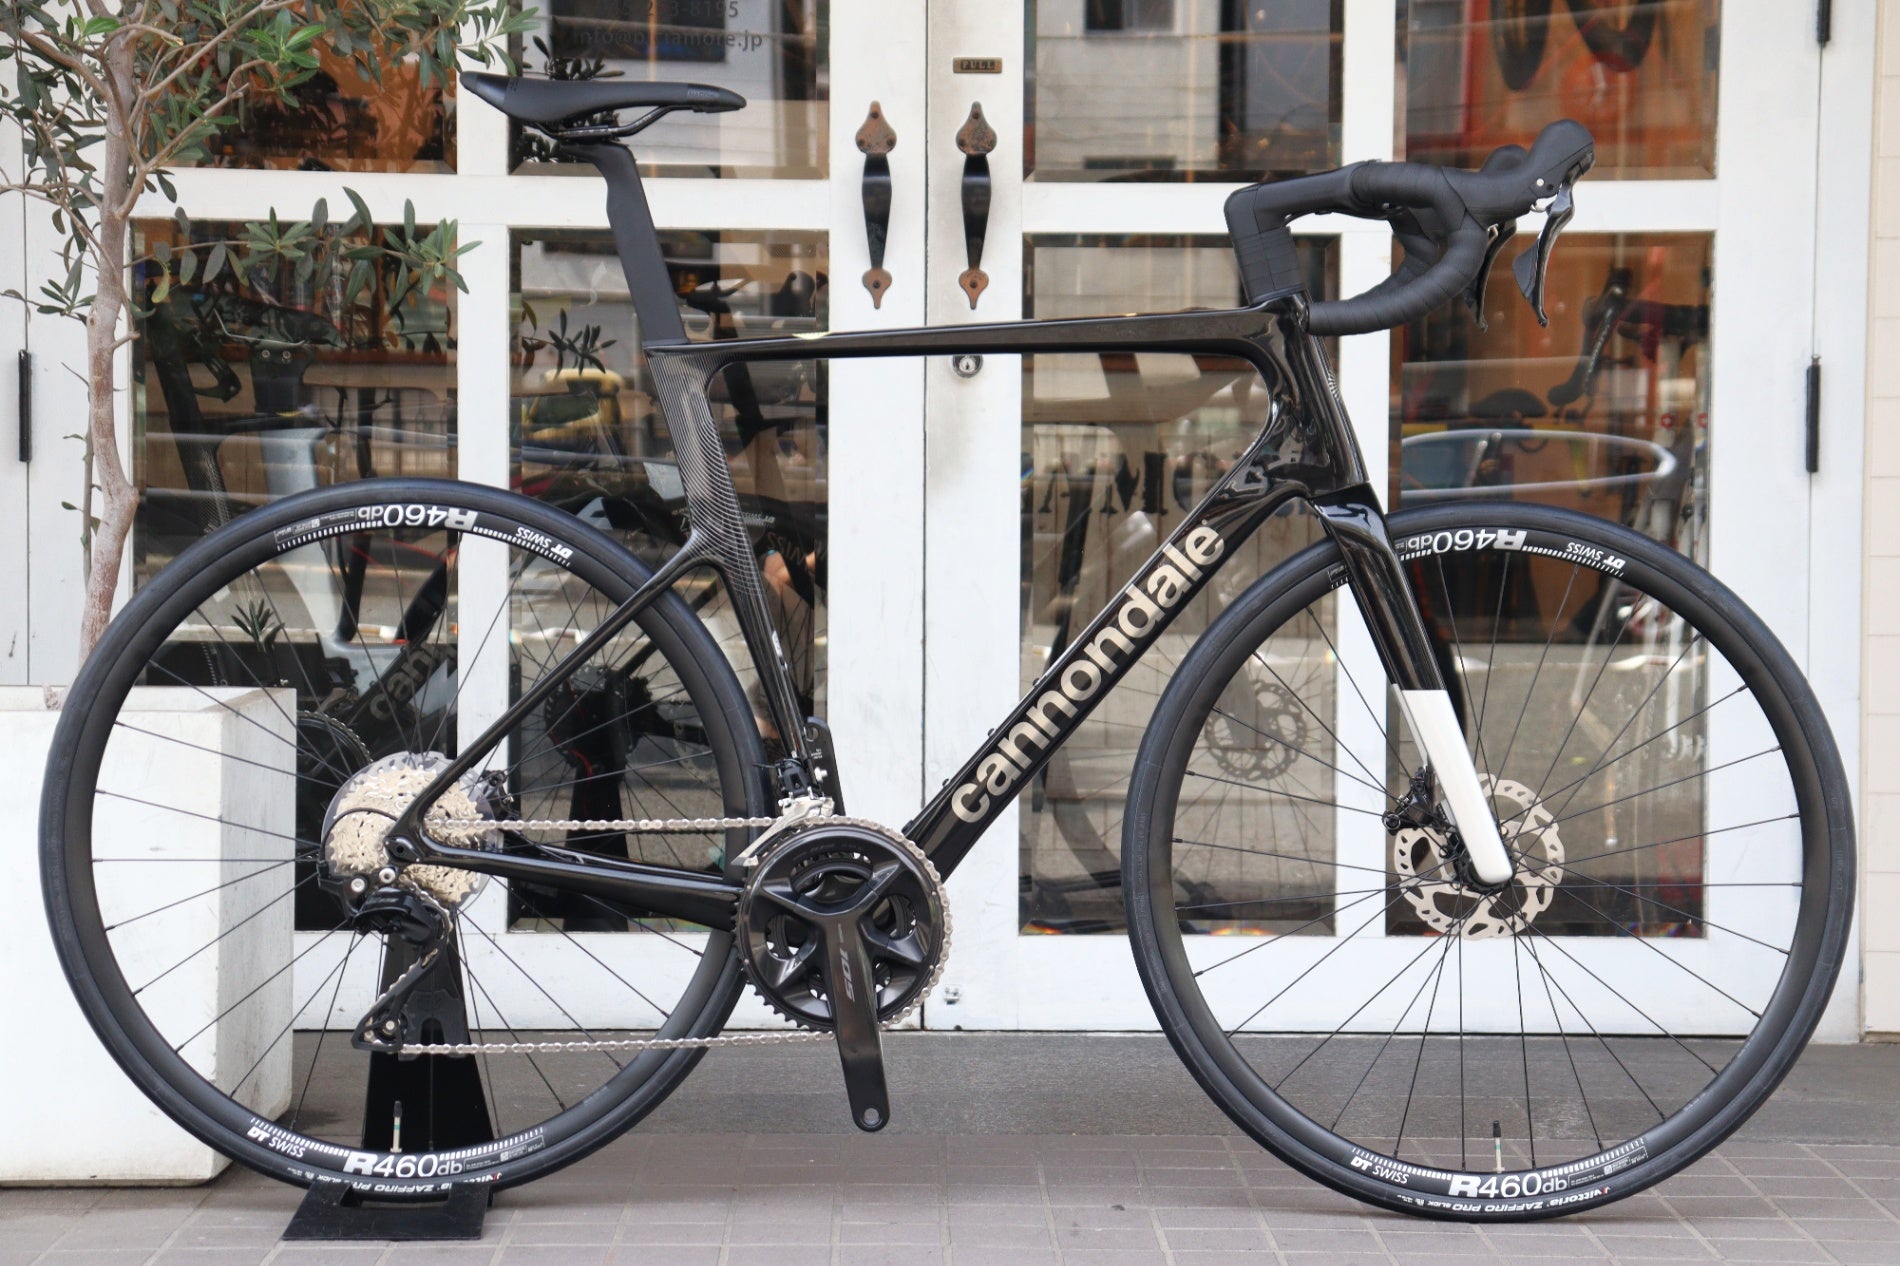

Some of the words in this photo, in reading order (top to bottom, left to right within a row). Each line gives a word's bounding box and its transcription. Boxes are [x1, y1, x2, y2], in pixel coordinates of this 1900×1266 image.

[962, 60, 994, 69] PULL
[357, 503, 478, 531] R460db
[515, 526, 552, 549] SWISS
[1407, 529, 1528, 553] R460db
[551, 543, 574, 559] DT
[1566, 541, 1604, 561] SWISS
[1603, 554, 1626, 570] DT
[951, 525, 1225, 824] cannondale
[839, 947, 856, 1003] 105
[247, 1125, 270, 1142] DT
[268, 1136, 306, 1158] SWISS
[343, 1151, 462, 1178] R460db
[1350, 1155, 1373, 1171] DT
[1372, 1165, 1410, 1185] SWISS
[1448, 1174, 1568, 1198] R460db
[1451, 1203, 1482, 1212] PRO
[1484, 1201, 1544, 1213] ZAFFIRO
